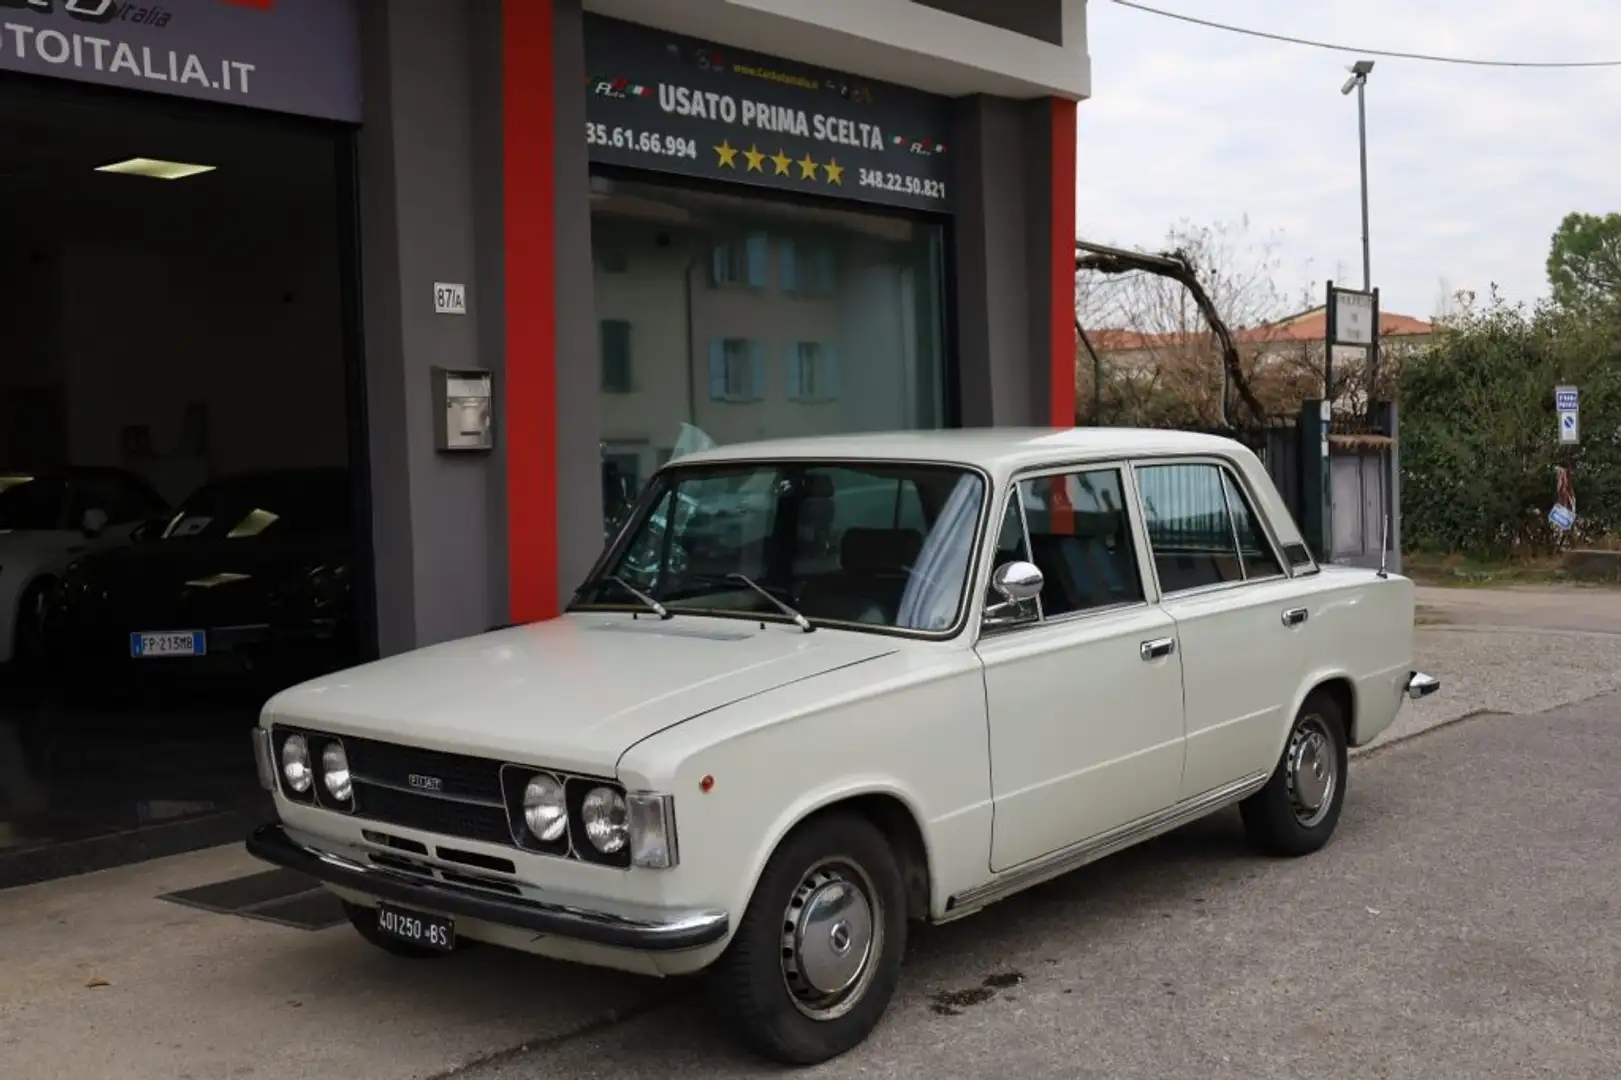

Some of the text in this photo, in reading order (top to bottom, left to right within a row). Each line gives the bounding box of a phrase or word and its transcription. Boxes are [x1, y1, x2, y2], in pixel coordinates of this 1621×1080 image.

[0, 22, 255, 93] TOITALIA.IT
[658, 82, 736, 123] USATO
[742, 99, 809, 138] PRIMA
[813, 114, 884, 151] SCELTA
[858, 167, 945, 199] 348.22.50.821
[437, 287, 463, 308] 87/A
[380, 908, 421, 940] 401250
